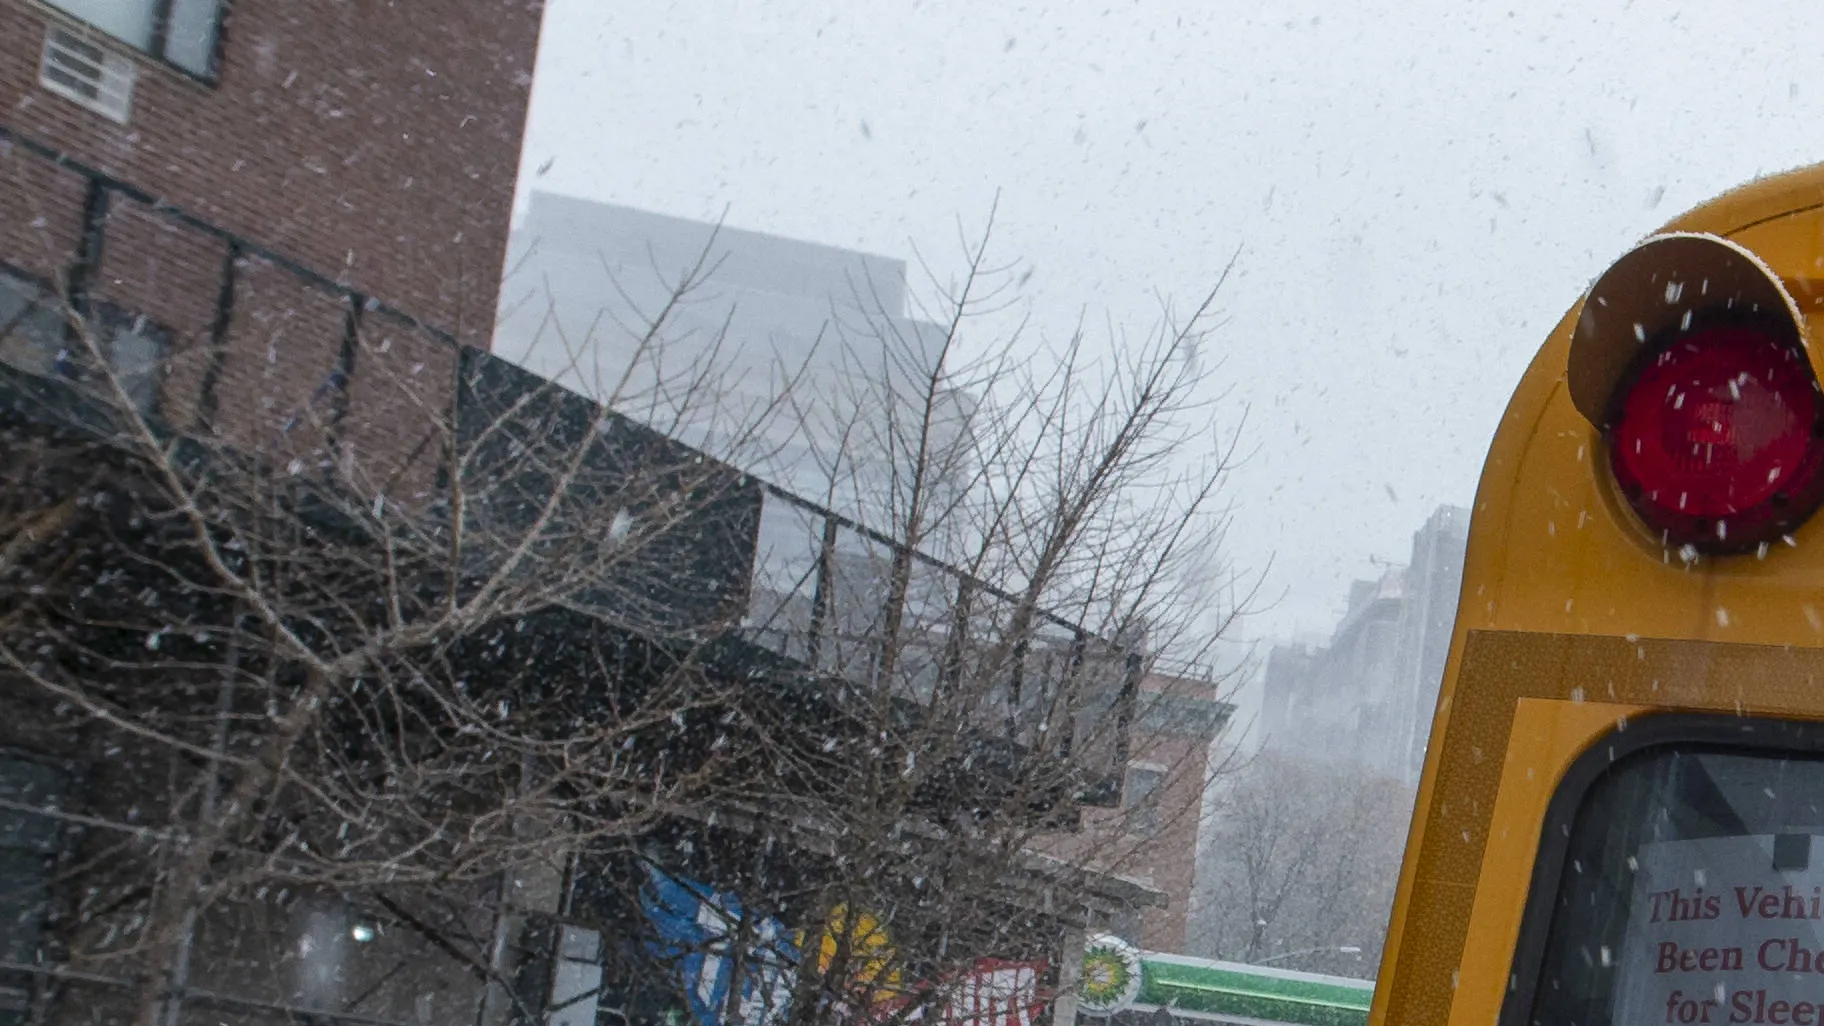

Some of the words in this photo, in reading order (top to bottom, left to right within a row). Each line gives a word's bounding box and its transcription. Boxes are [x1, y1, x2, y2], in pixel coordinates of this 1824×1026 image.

[1648, 887, 1720, 925] This
[1655, 940, 1743, 974] Been
[1665, 989, 1719, 1024] for
